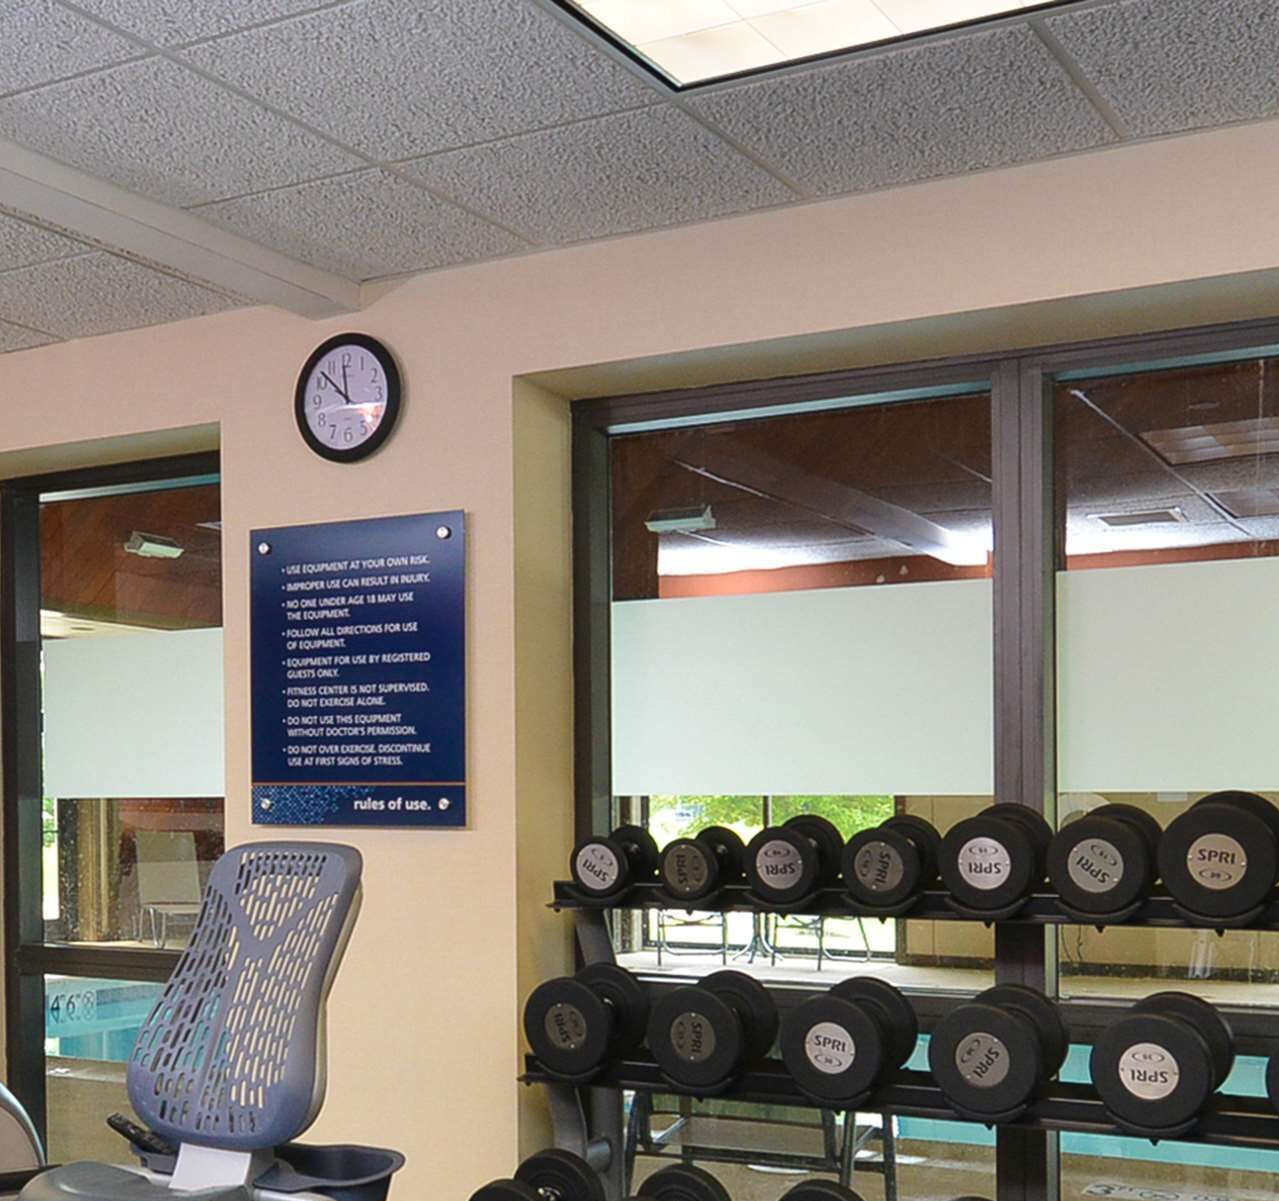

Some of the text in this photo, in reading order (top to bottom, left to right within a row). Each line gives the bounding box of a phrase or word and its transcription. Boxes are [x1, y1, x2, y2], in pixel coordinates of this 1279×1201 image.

[328, 361, 335, 374] 11
[342, 353, 352, 368] 12
[317, 376, 327, 390] 10
[371, 368, 377, 383] 2
[375, 386, 383, 401] 3
[313, 395, 321, 409] 9
[318, 412, 325, 427] 8
[329, 424, 336, 439] 7
[344, 427, 352, 442] 6
[287, 555, 430, 574] USE EQUIPMENT AT YOUR OWN RISK.
[287, 573, 430, 591] IMPROPER USE CAN RESULT IN INJURY.
[287, 592, 414, 608] NO ONE UNDER AGE 18 MAY USE
[287, 609, 350, 620] THE EQUIPMENT.
[287, 622, 417, 638] FOLLOW ALL DIRECTIONS FOR USE
[287, 638, 346, 650] OF EQUIPMENT.
[287, 652, 430, 667] EQUIPMENT FOR USE BY REGISTERED
[287, 668, 339, 678] GUESTS ONLY.
[288, 683, 429, 696] FITNESS CENTER IS NOT SUPERVISED.
[288, 696, 386, 707] DO NOT EXERCISE ALONE.
[288, 714, 401, 725] DO NOT USE THIS EQUIPMENT
[288, 726, 416, 736] WITHOUT DOCTOR'S PERMISSION.
[288, 743, 431, 754] DO NOT OVER EXERCISE. DISCONTINUE
[288, 756, 402, 766] USE AT FIRST SIGNS OF STRESS.
[354, 797, 431, 810] rules of use.
[1197, 848, 1236, 865] SPRI
[582, 858, 609, 882] SPRI
[676, 854, 688, 884] SPRI
[764, 863, 796, 876] SPRI
[874, 850, 891, 884] SPRI
[968, 862, 1001, 874] SPRI
[1076, 855, 1110, 883] SPRI
[691, 1021, 704, 1053] SPRI
[813, 1034, 846, 1053] SPRI
[972, 1046, 1000, 1079] SPRI
[1130, 1069, 1169, 1083] SPRI
